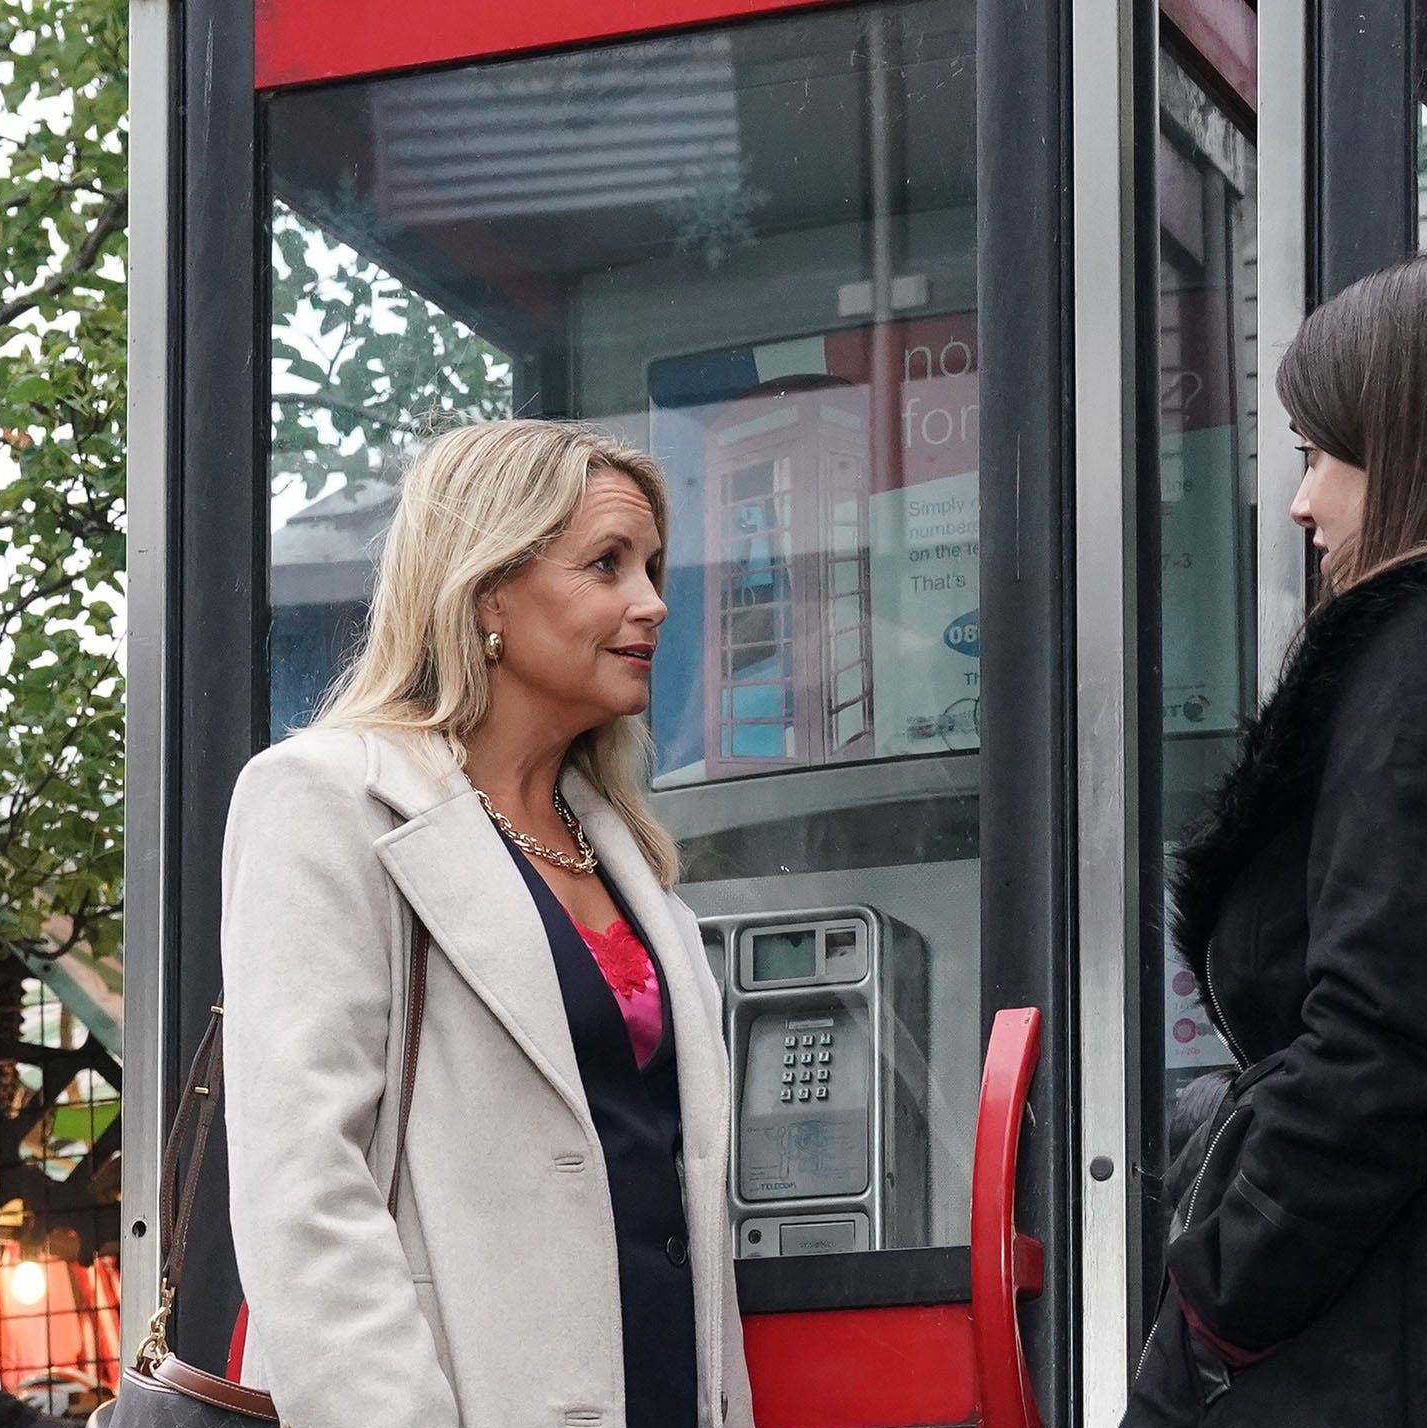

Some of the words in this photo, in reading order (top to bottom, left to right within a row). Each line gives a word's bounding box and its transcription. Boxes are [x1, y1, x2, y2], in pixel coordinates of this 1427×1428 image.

[904, 341, 972, 383] no
[908, 497, 965, 520] Simply
[909, 546, 930, 562] on
[935, 542, 961, 560] the
